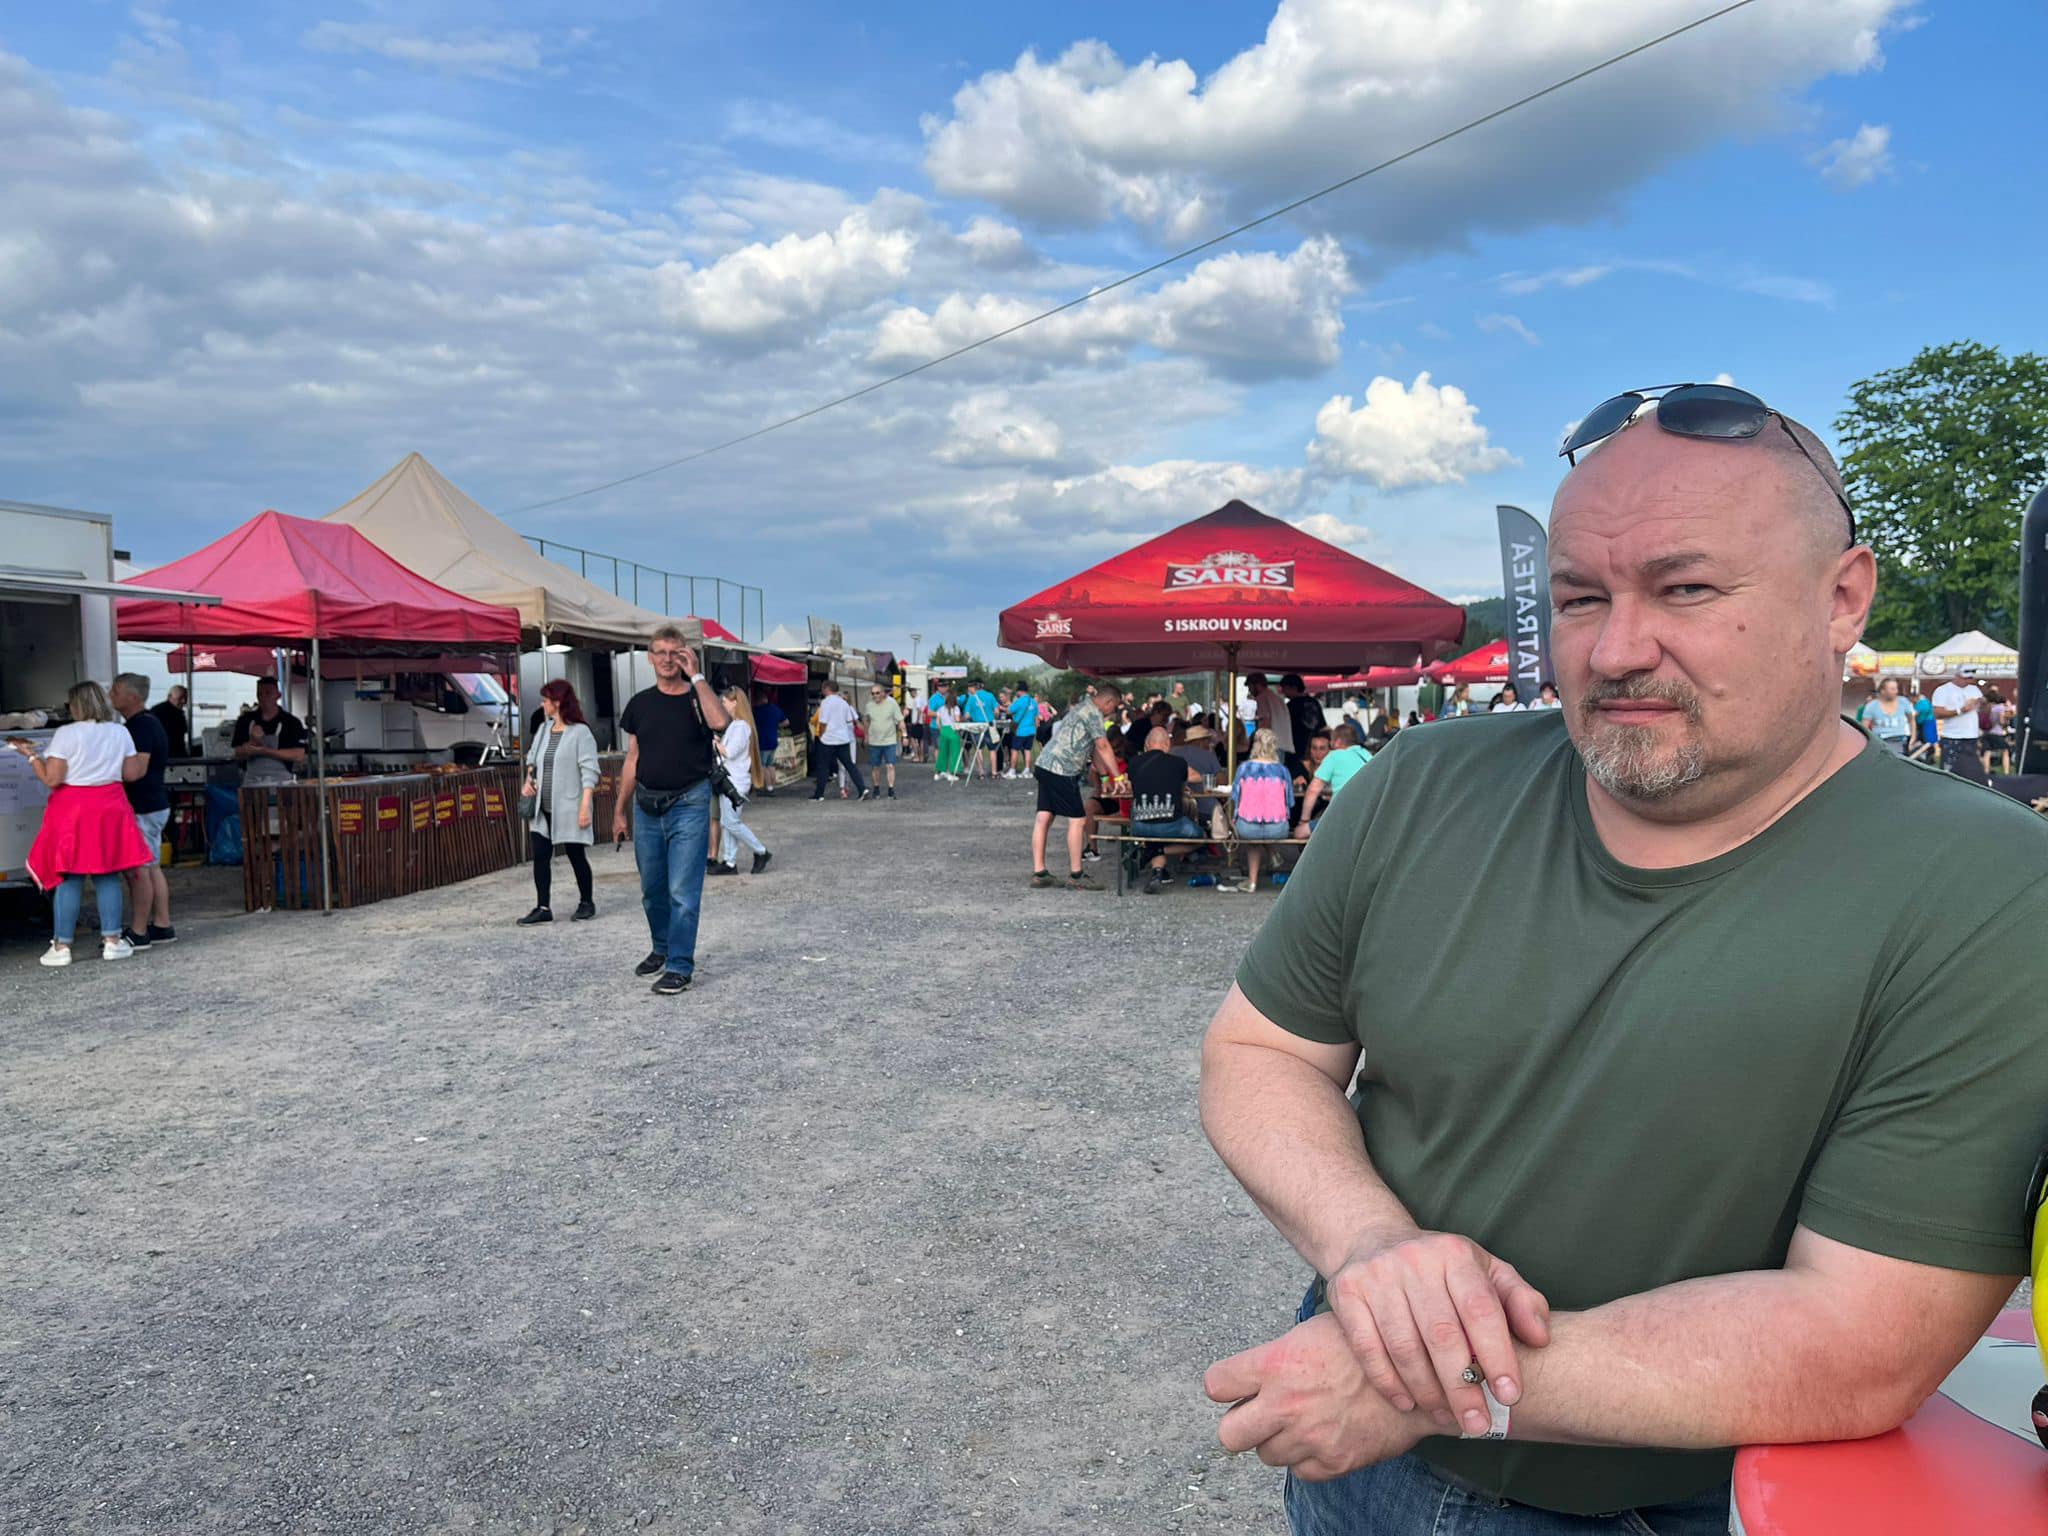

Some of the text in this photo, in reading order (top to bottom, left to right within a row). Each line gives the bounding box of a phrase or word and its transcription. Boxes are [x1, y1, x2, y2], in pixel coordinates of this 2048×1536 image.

[1164, 618, 1288, 632] S ISKROU V SRDCI
